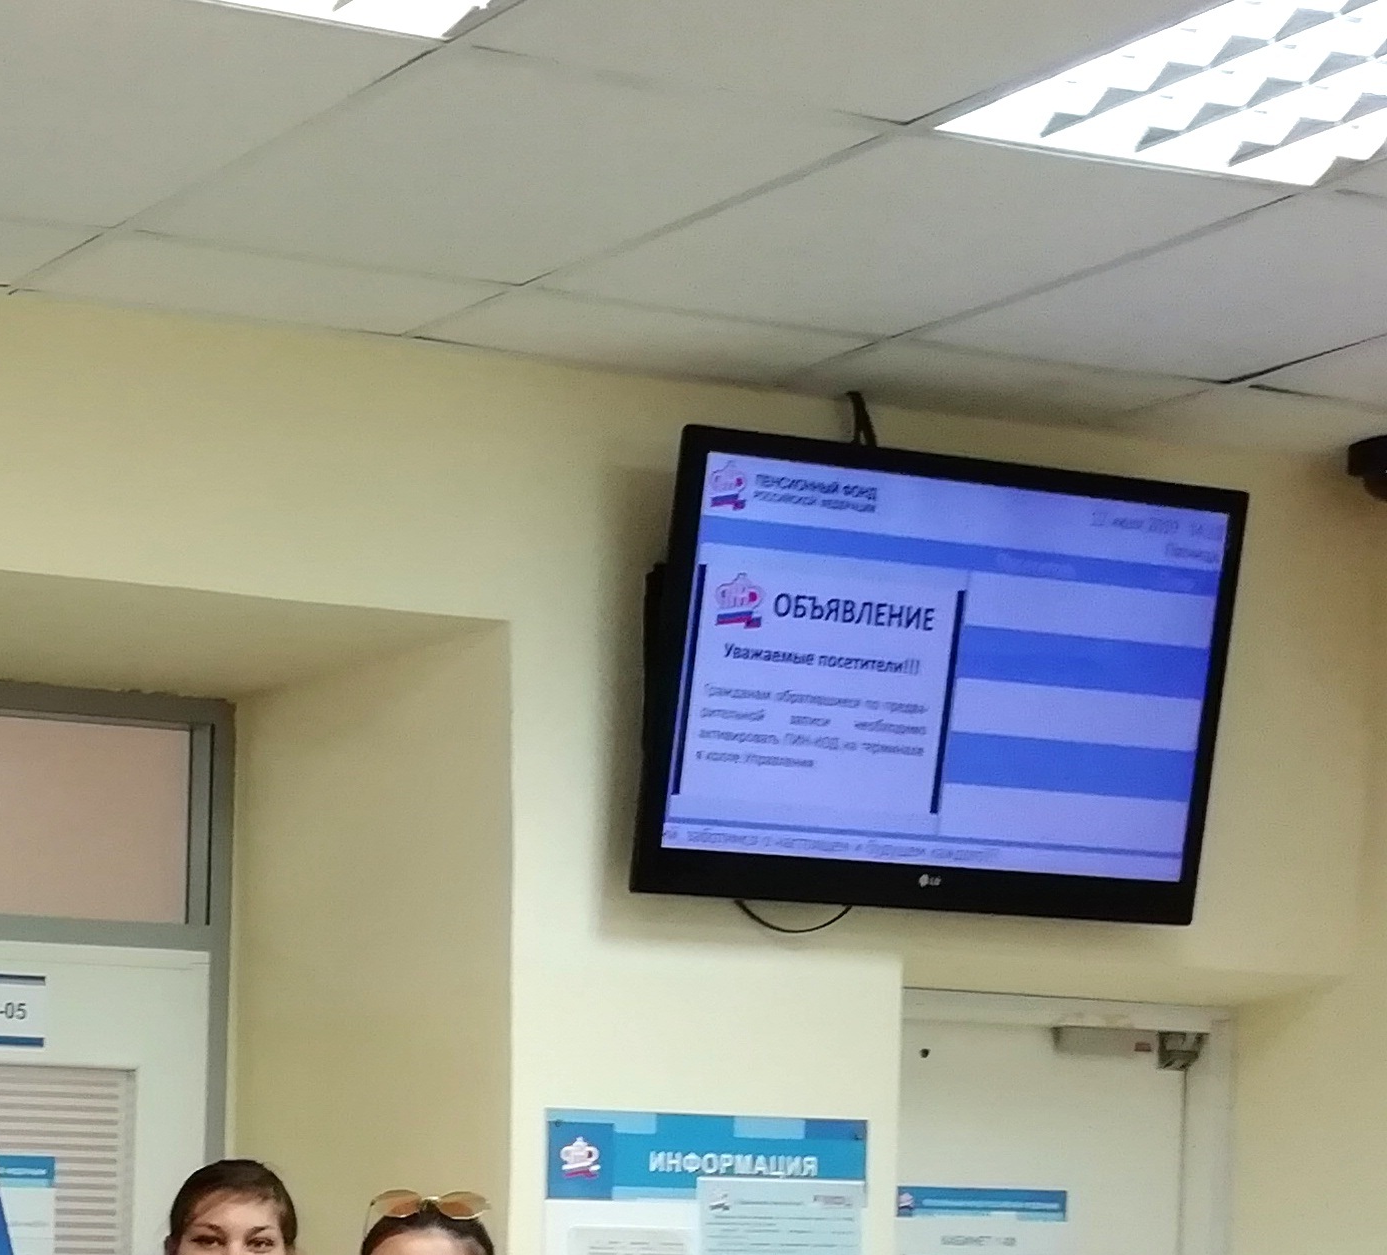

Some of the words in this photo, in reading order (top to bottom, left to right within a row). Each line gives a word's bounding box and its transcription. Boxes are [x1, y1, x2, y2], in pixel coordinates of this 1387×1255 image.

[774, 592, 935, 632] ОБЪЯВЛЕНИЕ
[723, 642, 814, 667] Уважаемые
[649, 1151, 818, 1178] ИНФОРМАЦИЯ
